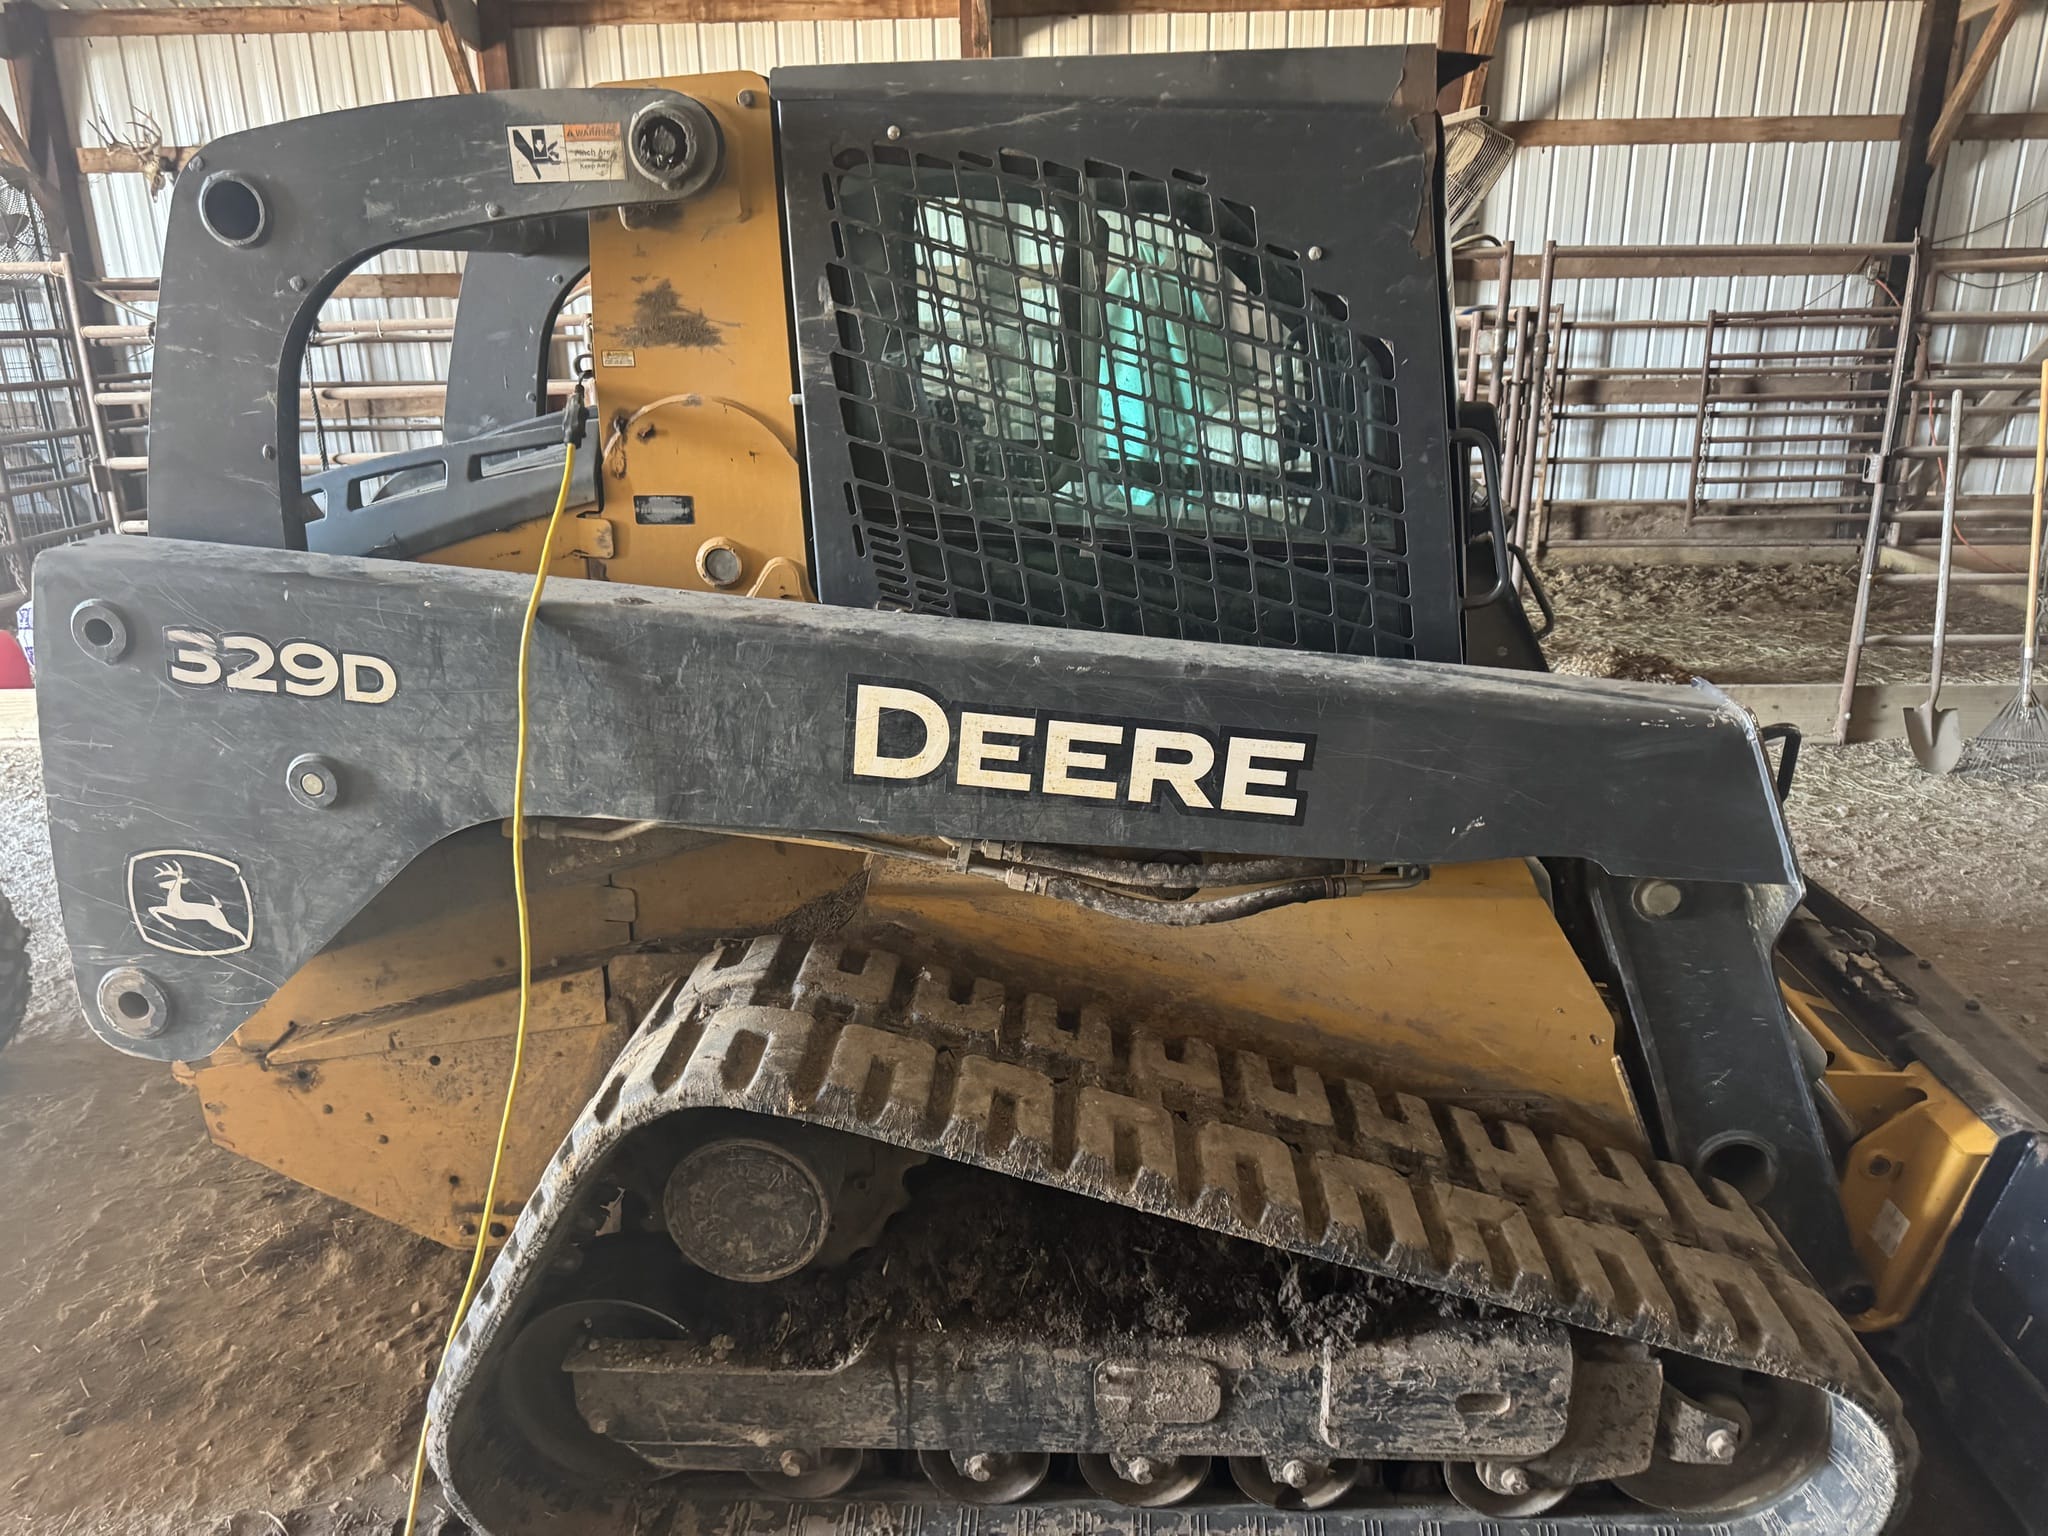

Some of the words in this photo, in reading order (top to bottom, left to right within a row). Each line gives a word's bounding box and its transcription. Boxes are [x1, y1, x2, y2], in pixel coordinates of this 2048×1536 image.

[576, 127, 616, 137] WARNING
[167, 629, 397, 704] 329D
[853, 684, 1306, 816] DEERE
